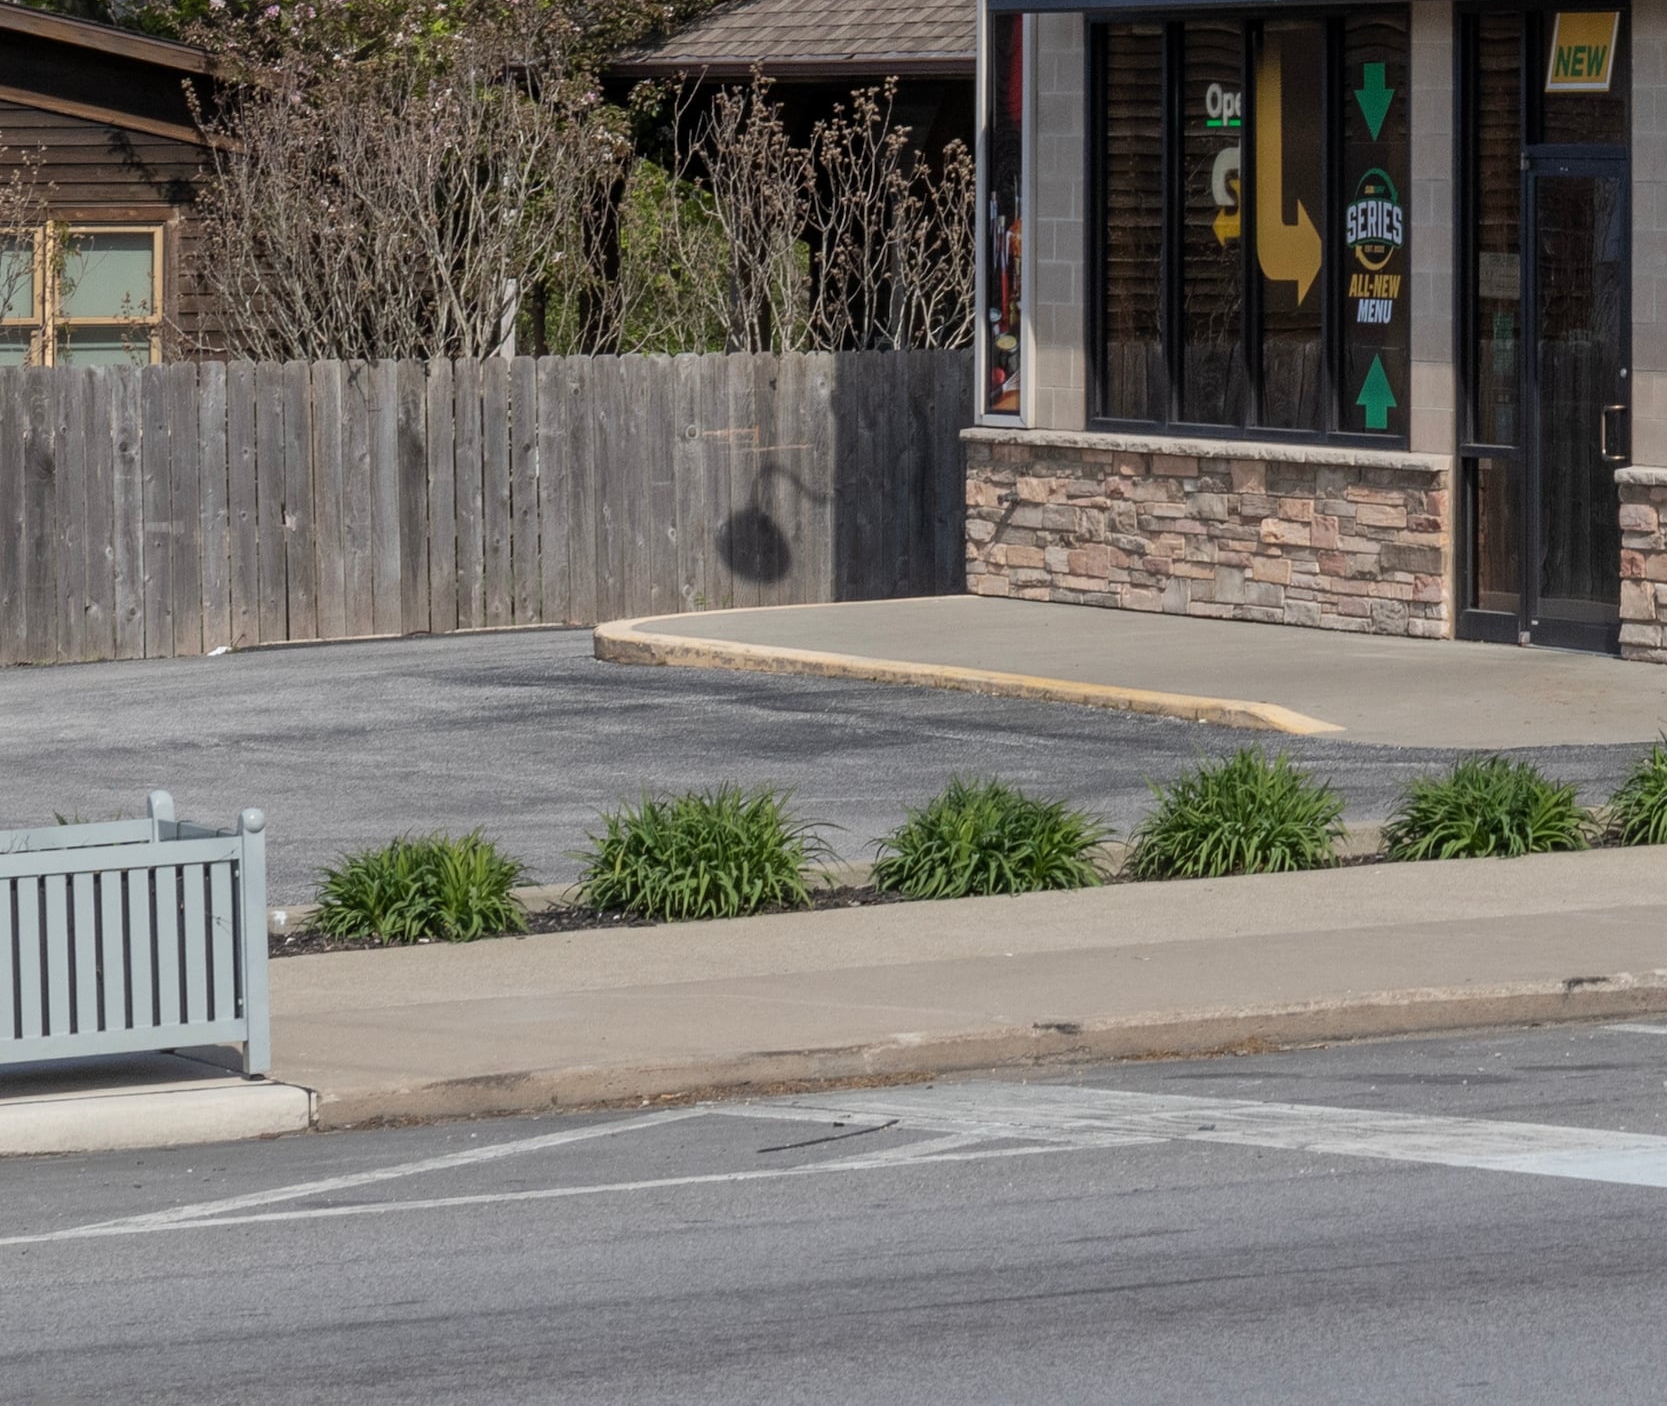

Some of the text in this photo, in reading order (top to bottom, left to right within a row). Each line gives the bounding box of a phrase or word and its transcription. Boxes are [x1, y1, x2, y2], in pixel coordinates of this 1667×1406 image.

[1555, 45, 1607, 77] NEW
[1346, 200, 1403, 245] SERIES
[1349, 273, 1401, 299] ALL-NEW
[1356, 299, 1393, 324] MENU
